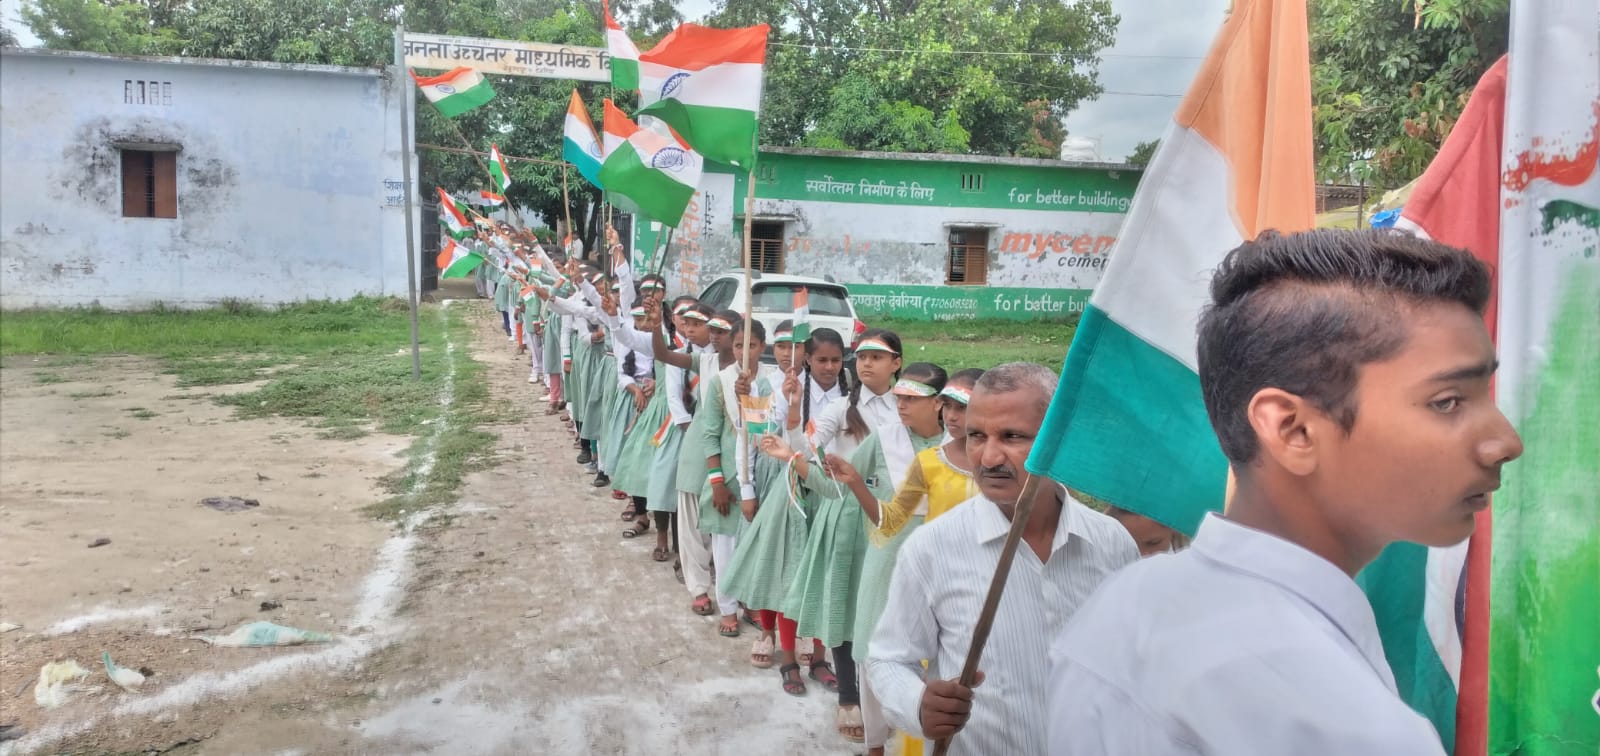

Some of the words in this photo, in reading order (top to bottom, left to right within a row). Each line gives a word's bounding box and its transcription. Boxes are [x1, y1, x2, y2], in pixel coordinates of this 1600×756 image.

[514, 48, 592, 69] माध्यमिक
[805, 174, 856, 196] सर्वोत्तम
[858, 178, 896, 198] निर्माण
[896, 180, 908, 198] के
[910, 182, 935, 201] लिए
[1008, 187, 1032, 203] for
[1036, 188, 1075, 205] better
[994, 293, 1021, 311] for
[1024, 293, 1066, 312] better
